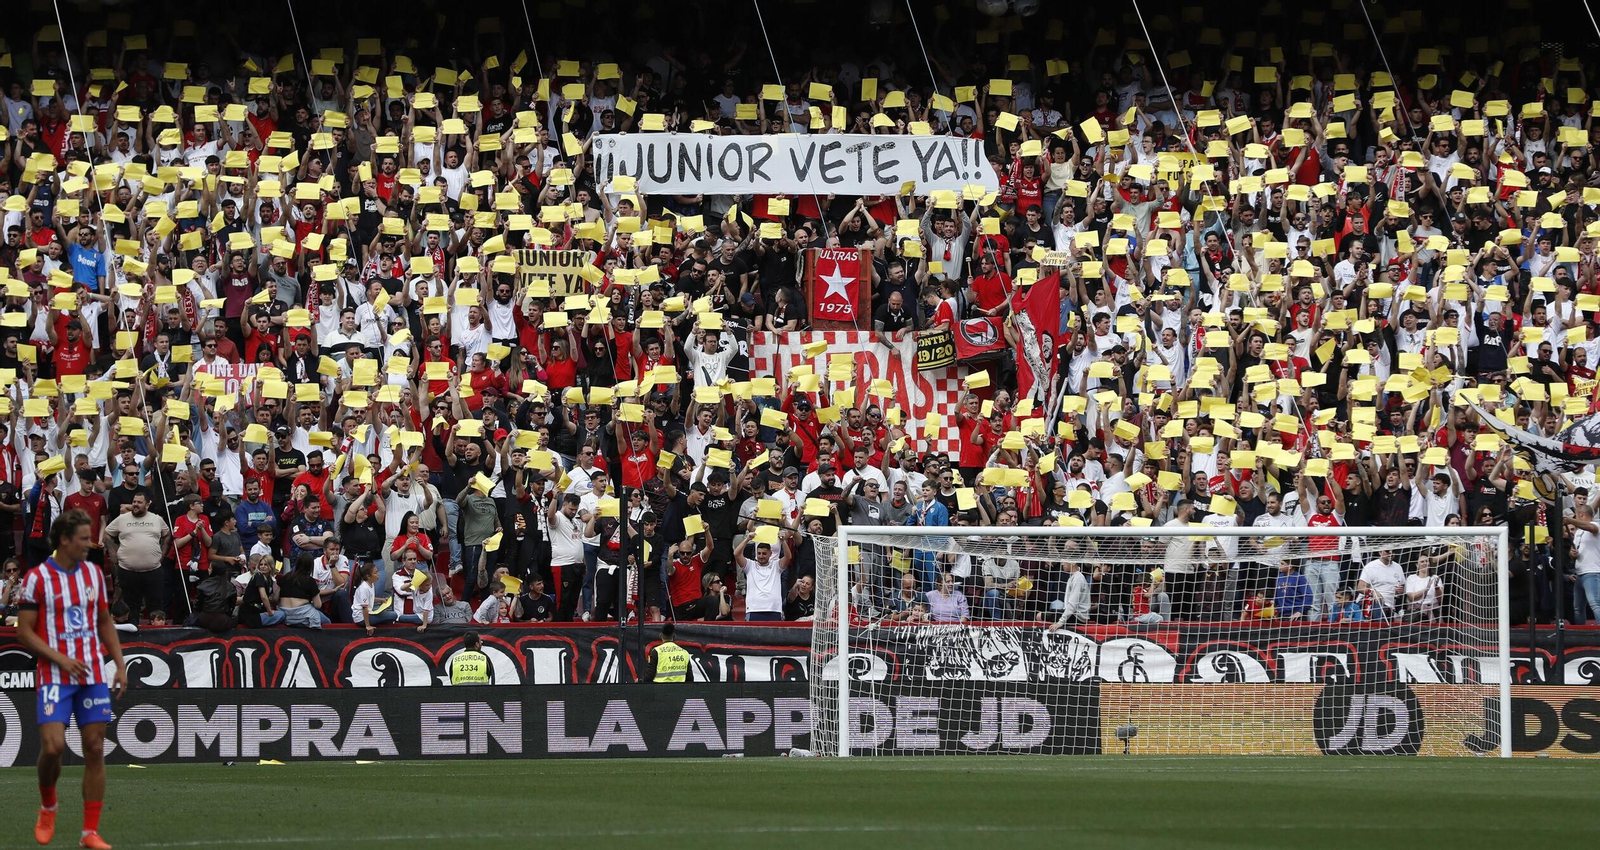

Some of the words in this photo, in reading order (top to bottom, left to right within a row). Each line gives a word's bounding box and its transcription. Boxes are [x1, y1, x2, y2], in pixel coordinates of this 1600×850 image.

[789, 142, 900, 185] VETE
[911, 139, 982, 183] YA!!
[518, 250, 585, 267] JUNIOR
[820, 249, 859, 261] ULTRAS
[563, 273, 584, 293] YA
[819, 302, 853, 313] 1975
[917, 344, 953, 362] 19/20
[708, 498, 726, 509] BOSS
[454, 654, 486, 662] SEGURIDAD
[460, 664, 478, 672] 2334
[41, 685, 60, 703] 14
[66, 703, 400, 759] COMPRA
[420, 702, 523, 755] EN
[546, 700, 649, 753] LA
[666, 697, 823, 751] APP
[845, 696, 940, 749] DE
[959, 696, 1051, 750] JD
[1328, 694, 1410, 750] JD
